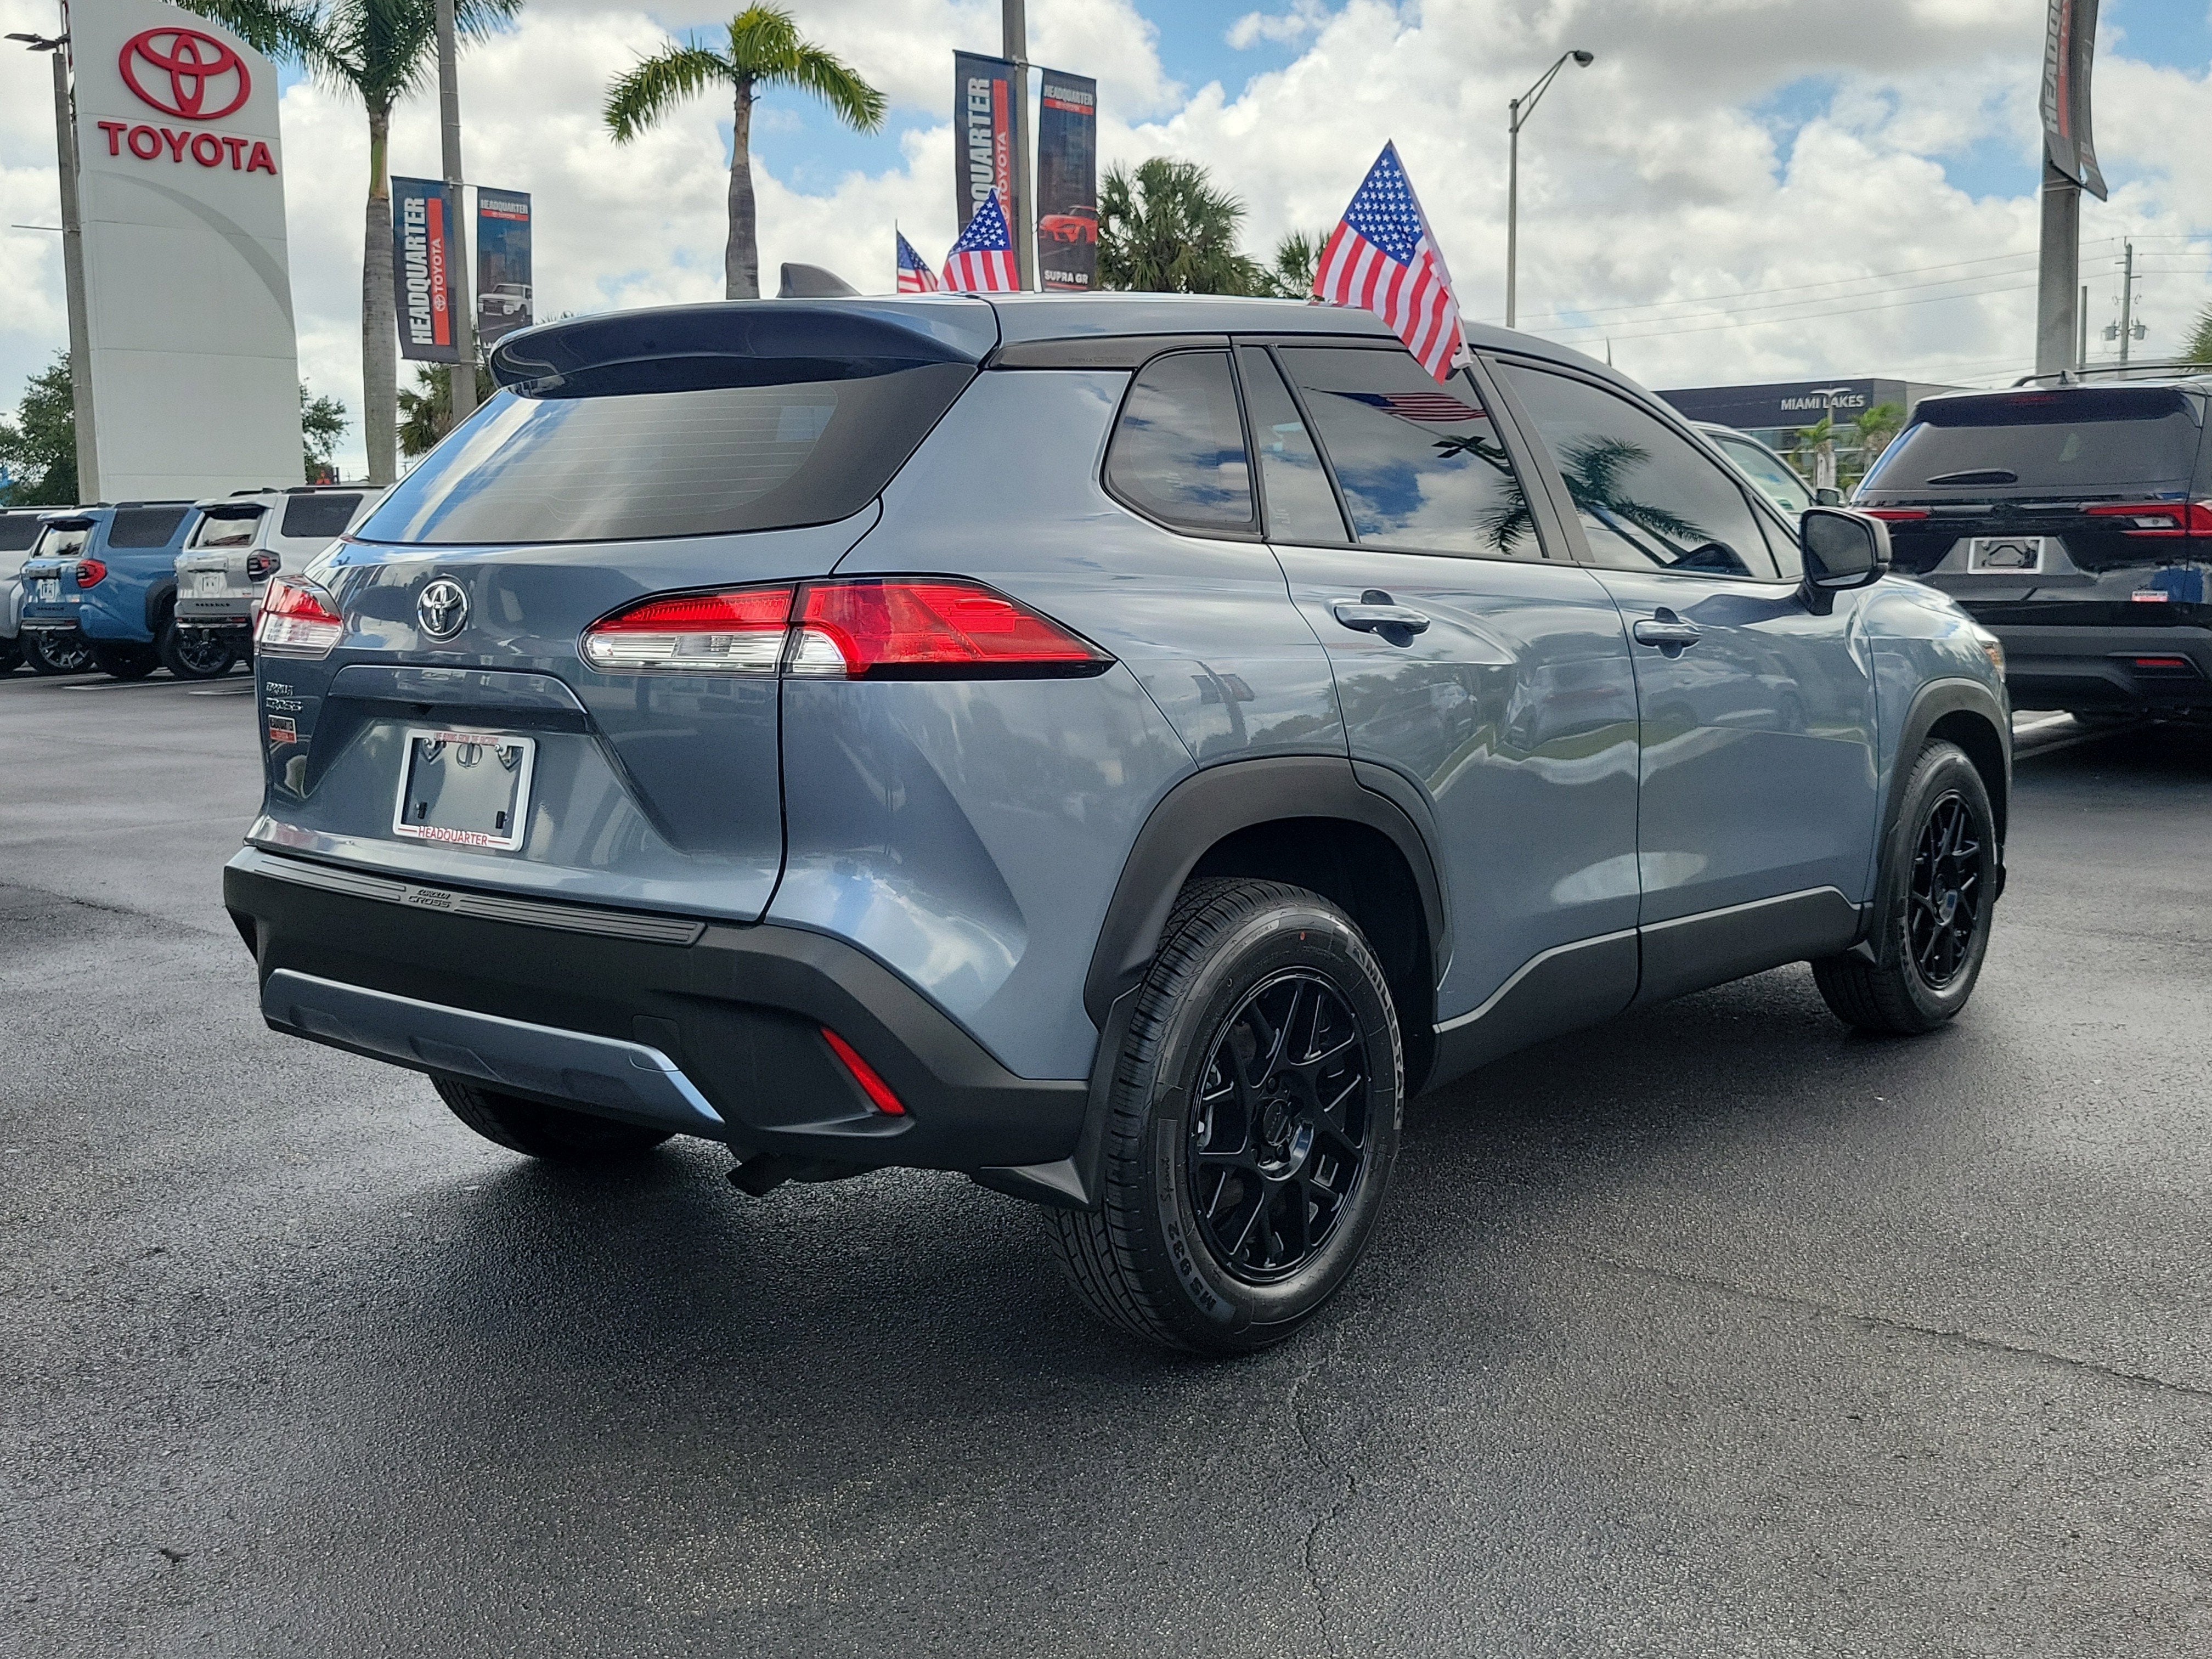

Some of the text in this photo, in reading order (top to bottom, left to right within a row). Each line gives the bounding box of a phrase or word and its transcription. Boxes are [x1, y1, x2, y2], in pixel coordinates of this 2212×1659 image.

[98, 121, 278, 175] TOYOTA
[997, 132, 1008, 204] TOYOTA
[404, 198, 433, 345] HEADQUARTER
[431, 238, 444, 293] TOYOTA
[1044, 269, 1088, 285] SUPRA GR
[1781, 394, 1865, 411] MIAMI LAKES
[419, 825, 487, 845] HEADQUARTER
[408, 895, 452, 908] CROSS
[1365, 958, 1404, 1121] MILESTAR
